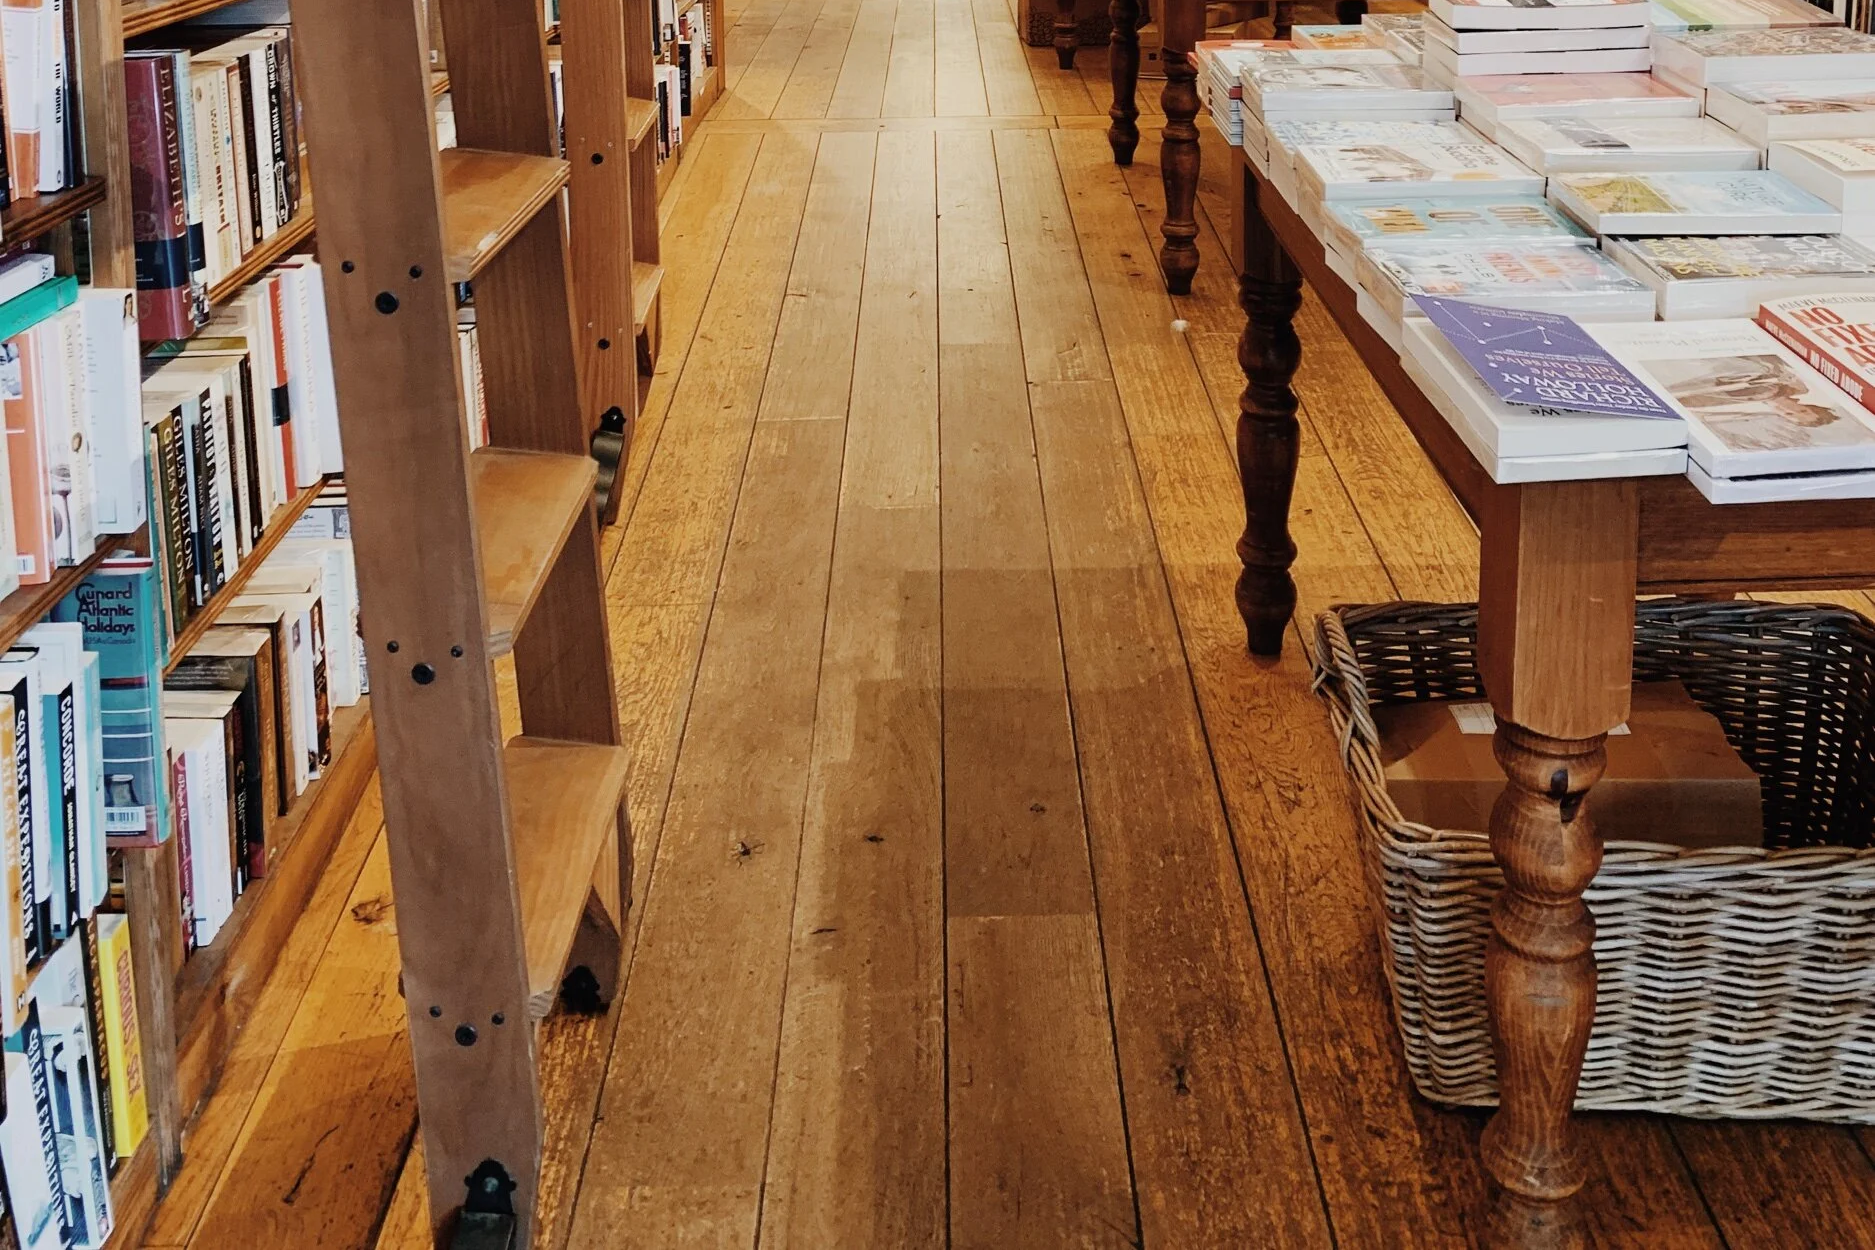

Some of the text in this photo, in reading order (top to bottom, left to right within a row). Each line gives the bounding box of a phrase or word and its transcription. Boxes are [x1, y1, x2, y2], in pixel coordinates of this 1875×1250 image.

[266, 49, 277, 90] CROWN
[159, 68, 185, 225] ELIZABETH'S
[269, 107, 282, 154] THISTLES
[215, 164, 226, 224] BRITAIN
[1427, 211, 1491, 226] OF
[1487, 205, 1559, 228] ONE
[1481, 252, 1540, 284] FRIENDS
[1788, 306, 1844, 329] NO
[1811, 323, 1875, 348] FIXE
[1484, 352, 1584, 373] Ourselves
[1529, 366, 1635, 387] Stories We
[1810, 349, 1820, 368] NO
[1820, 356, 1840, 384] FIXED
[1502, 371, 1648, 398] HOLLOWAY
[1536, 386, 1661, 409] RICHARD
[201, 397, 216, 469] PATRIOT
[163, 427, 185, 583] GILES MILTON
[173, 415, 194, 570] GILES MILTON
[207, 478, 222, 547] TRAITOR
[75, 582, 133, 603] Cunard
[77, 600, 135, 618] Atlantic
[78, 617, 136, 635] Holidays
[60, 695, 76, 796] CONCORDE
[16, 708, 34, 939] GREAT EXPEDITIONS
[86, 918, 97, 969] LACK
[93, 975, 109, 1080] SPARTACUS
[117, 949, 135, 1046] CURIOUS
[127, 1053, 142, 1106] SEX
[28, 1028, 66, 1231] GREAT EXPEDITIONS
